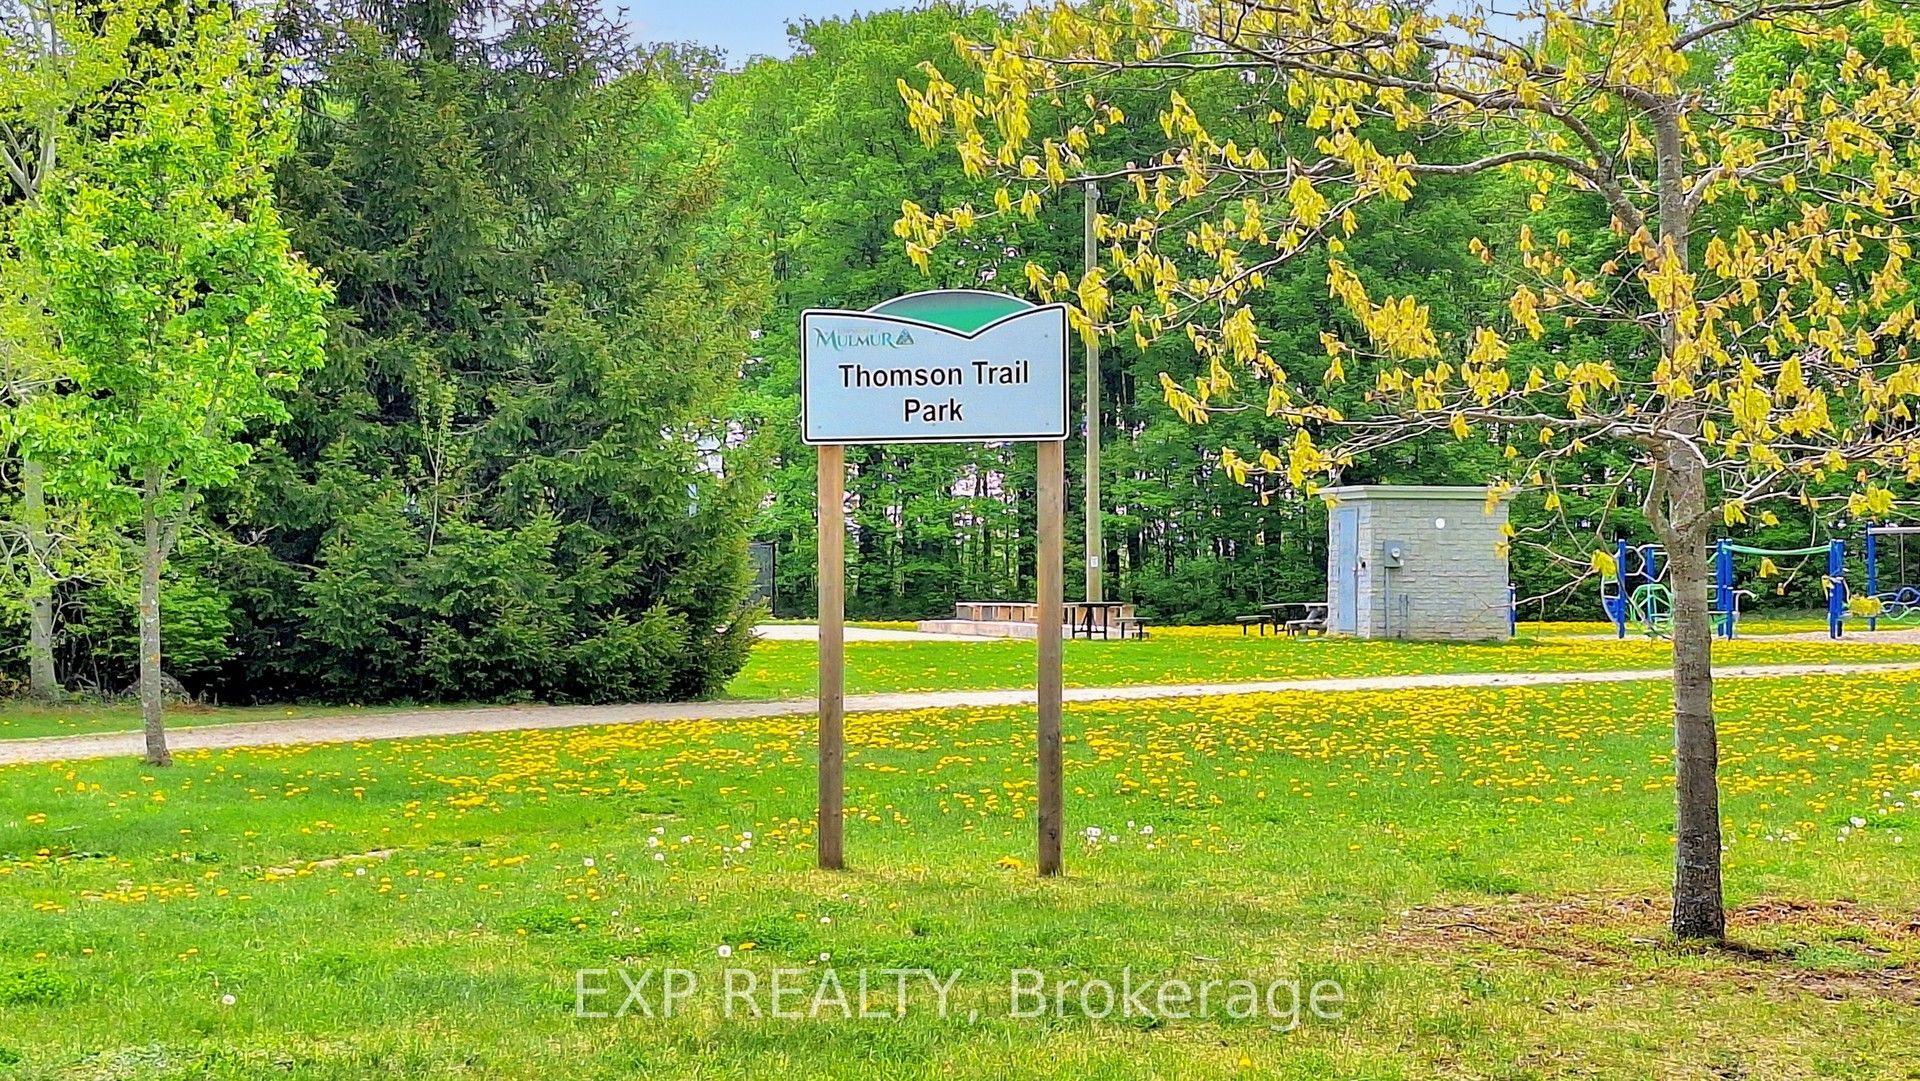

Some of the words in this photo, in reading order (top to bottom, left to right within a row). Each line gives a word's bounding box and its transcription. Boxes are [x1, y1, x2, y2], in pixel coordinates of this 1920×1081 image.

[813, 327, 898, 351] MULMUR
[839, 364, 962, 387] Thomson
[972, 361, 1029, 385] Trail
[904, 399, 963, 422] Park
